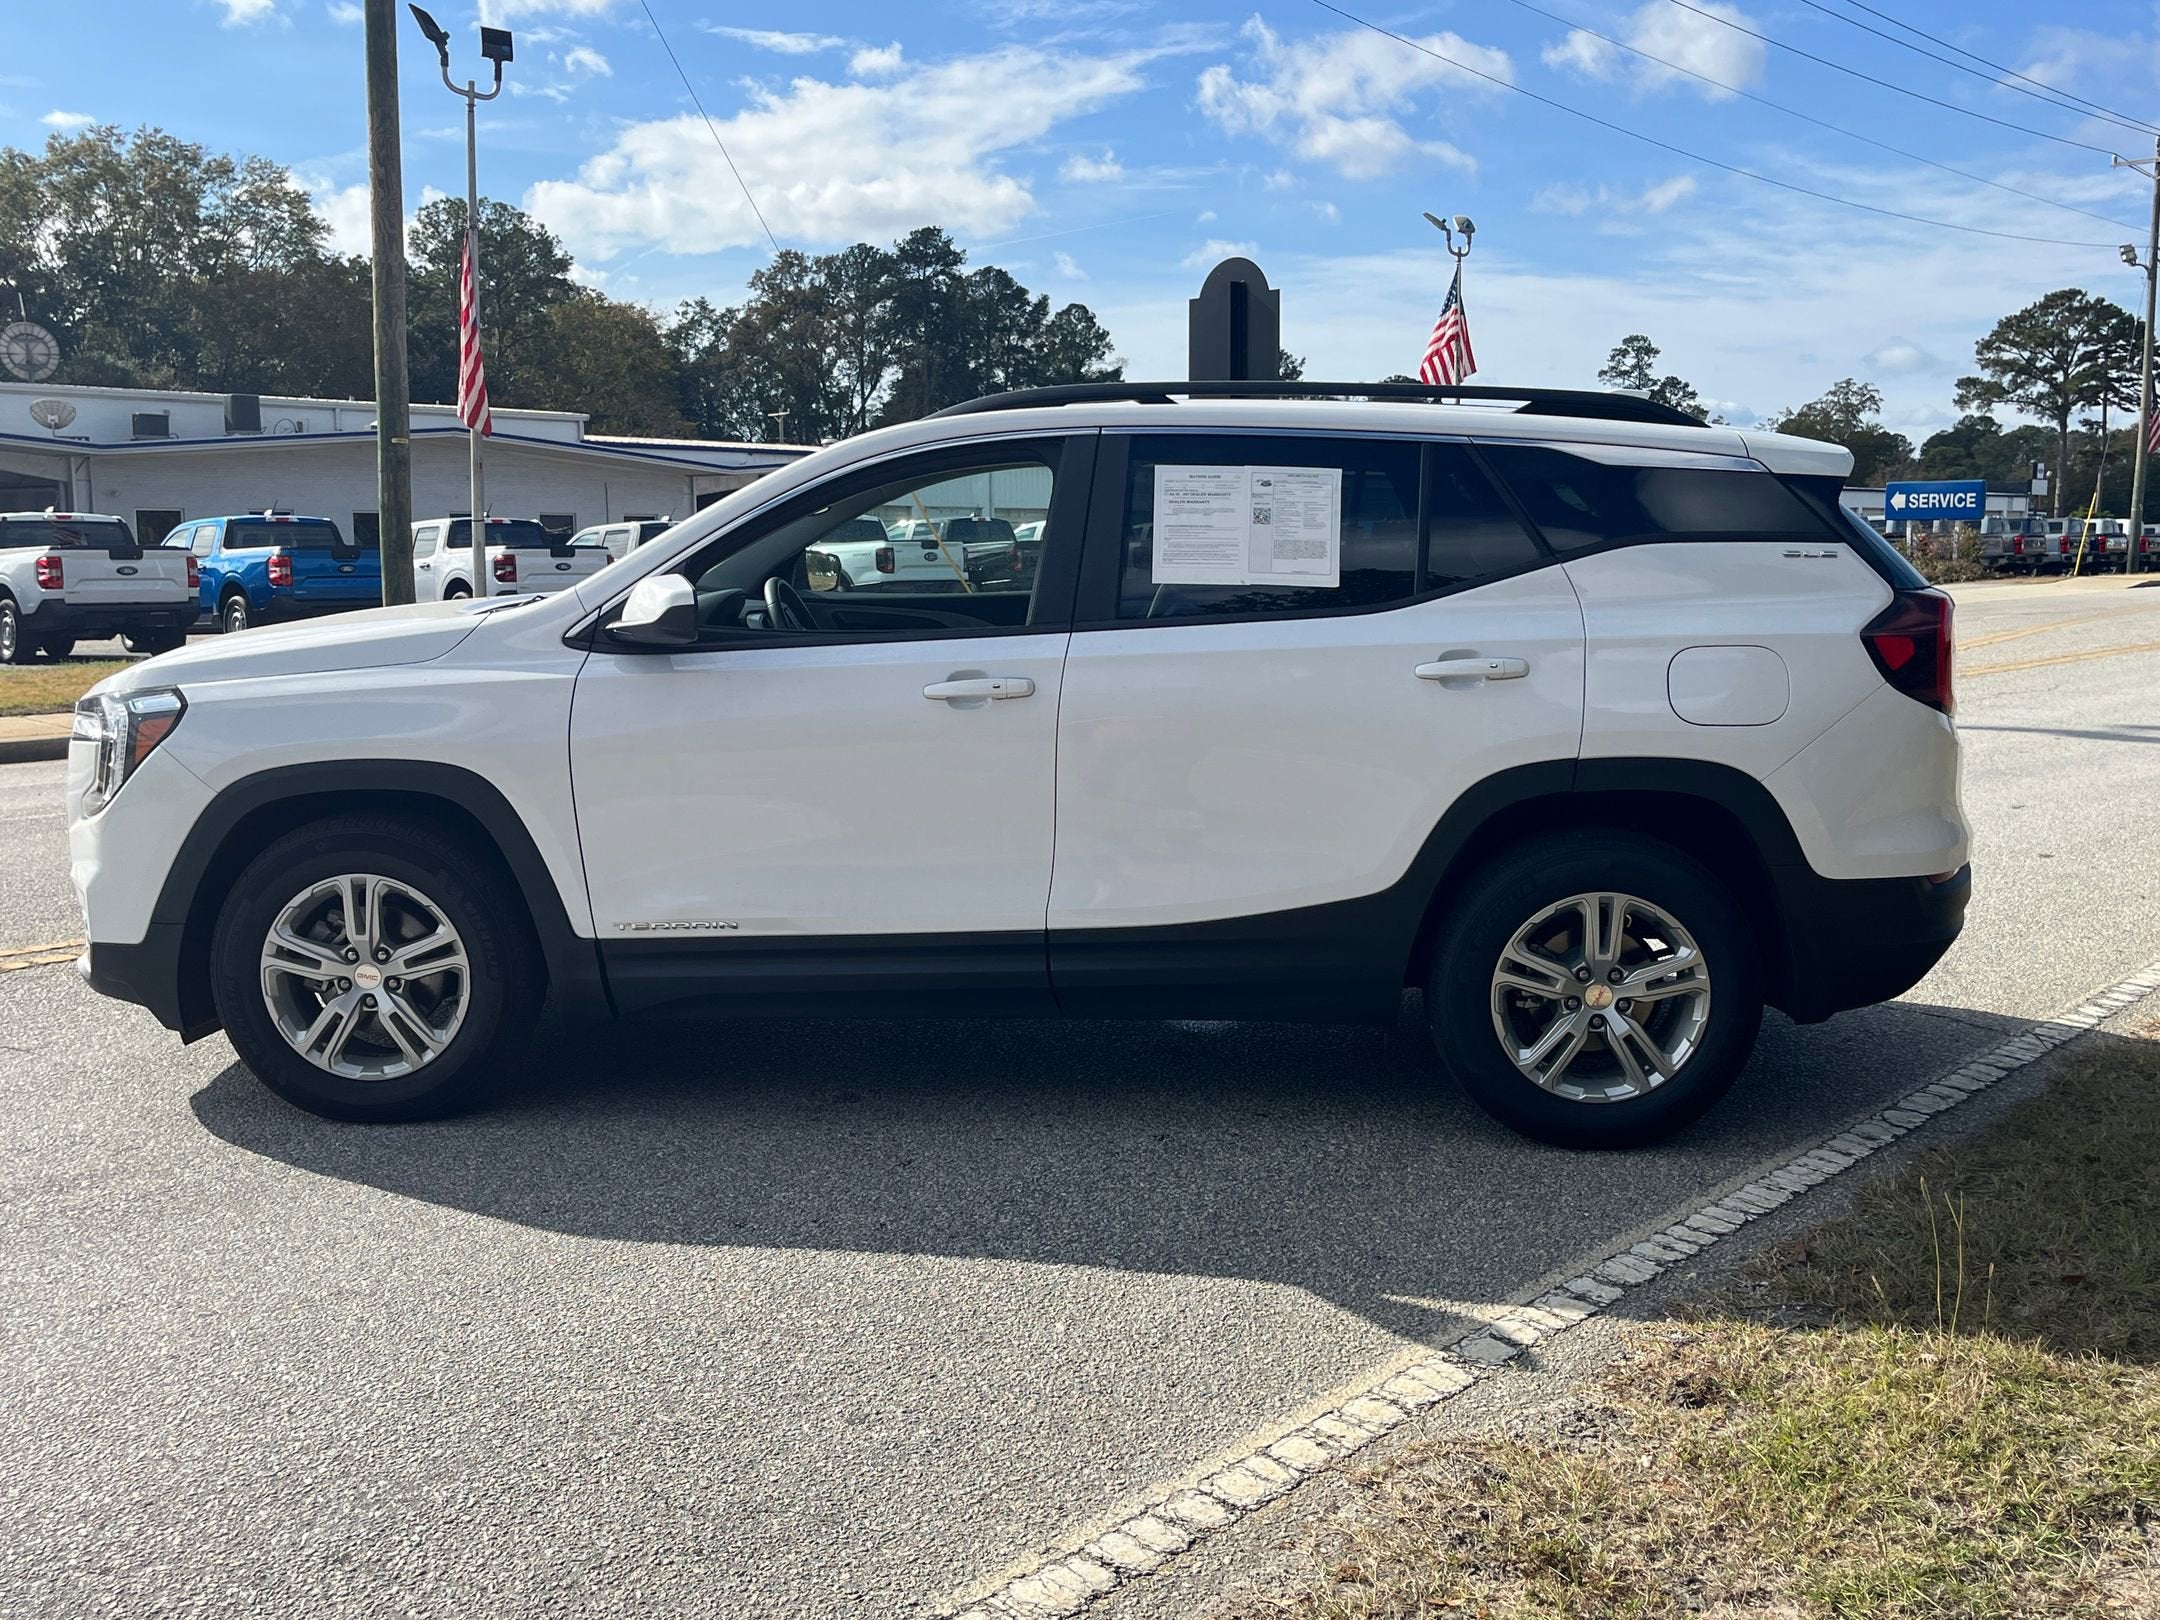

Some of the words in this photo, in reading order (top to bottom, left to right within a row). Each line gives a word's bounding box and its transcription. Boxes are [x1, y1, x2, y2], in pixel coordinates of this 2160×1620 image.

[1908, 492, 1977, 509] SERVICE
[613, 921, 739, 931] TERRAIN
[356, 972, 379, 981] GMC
